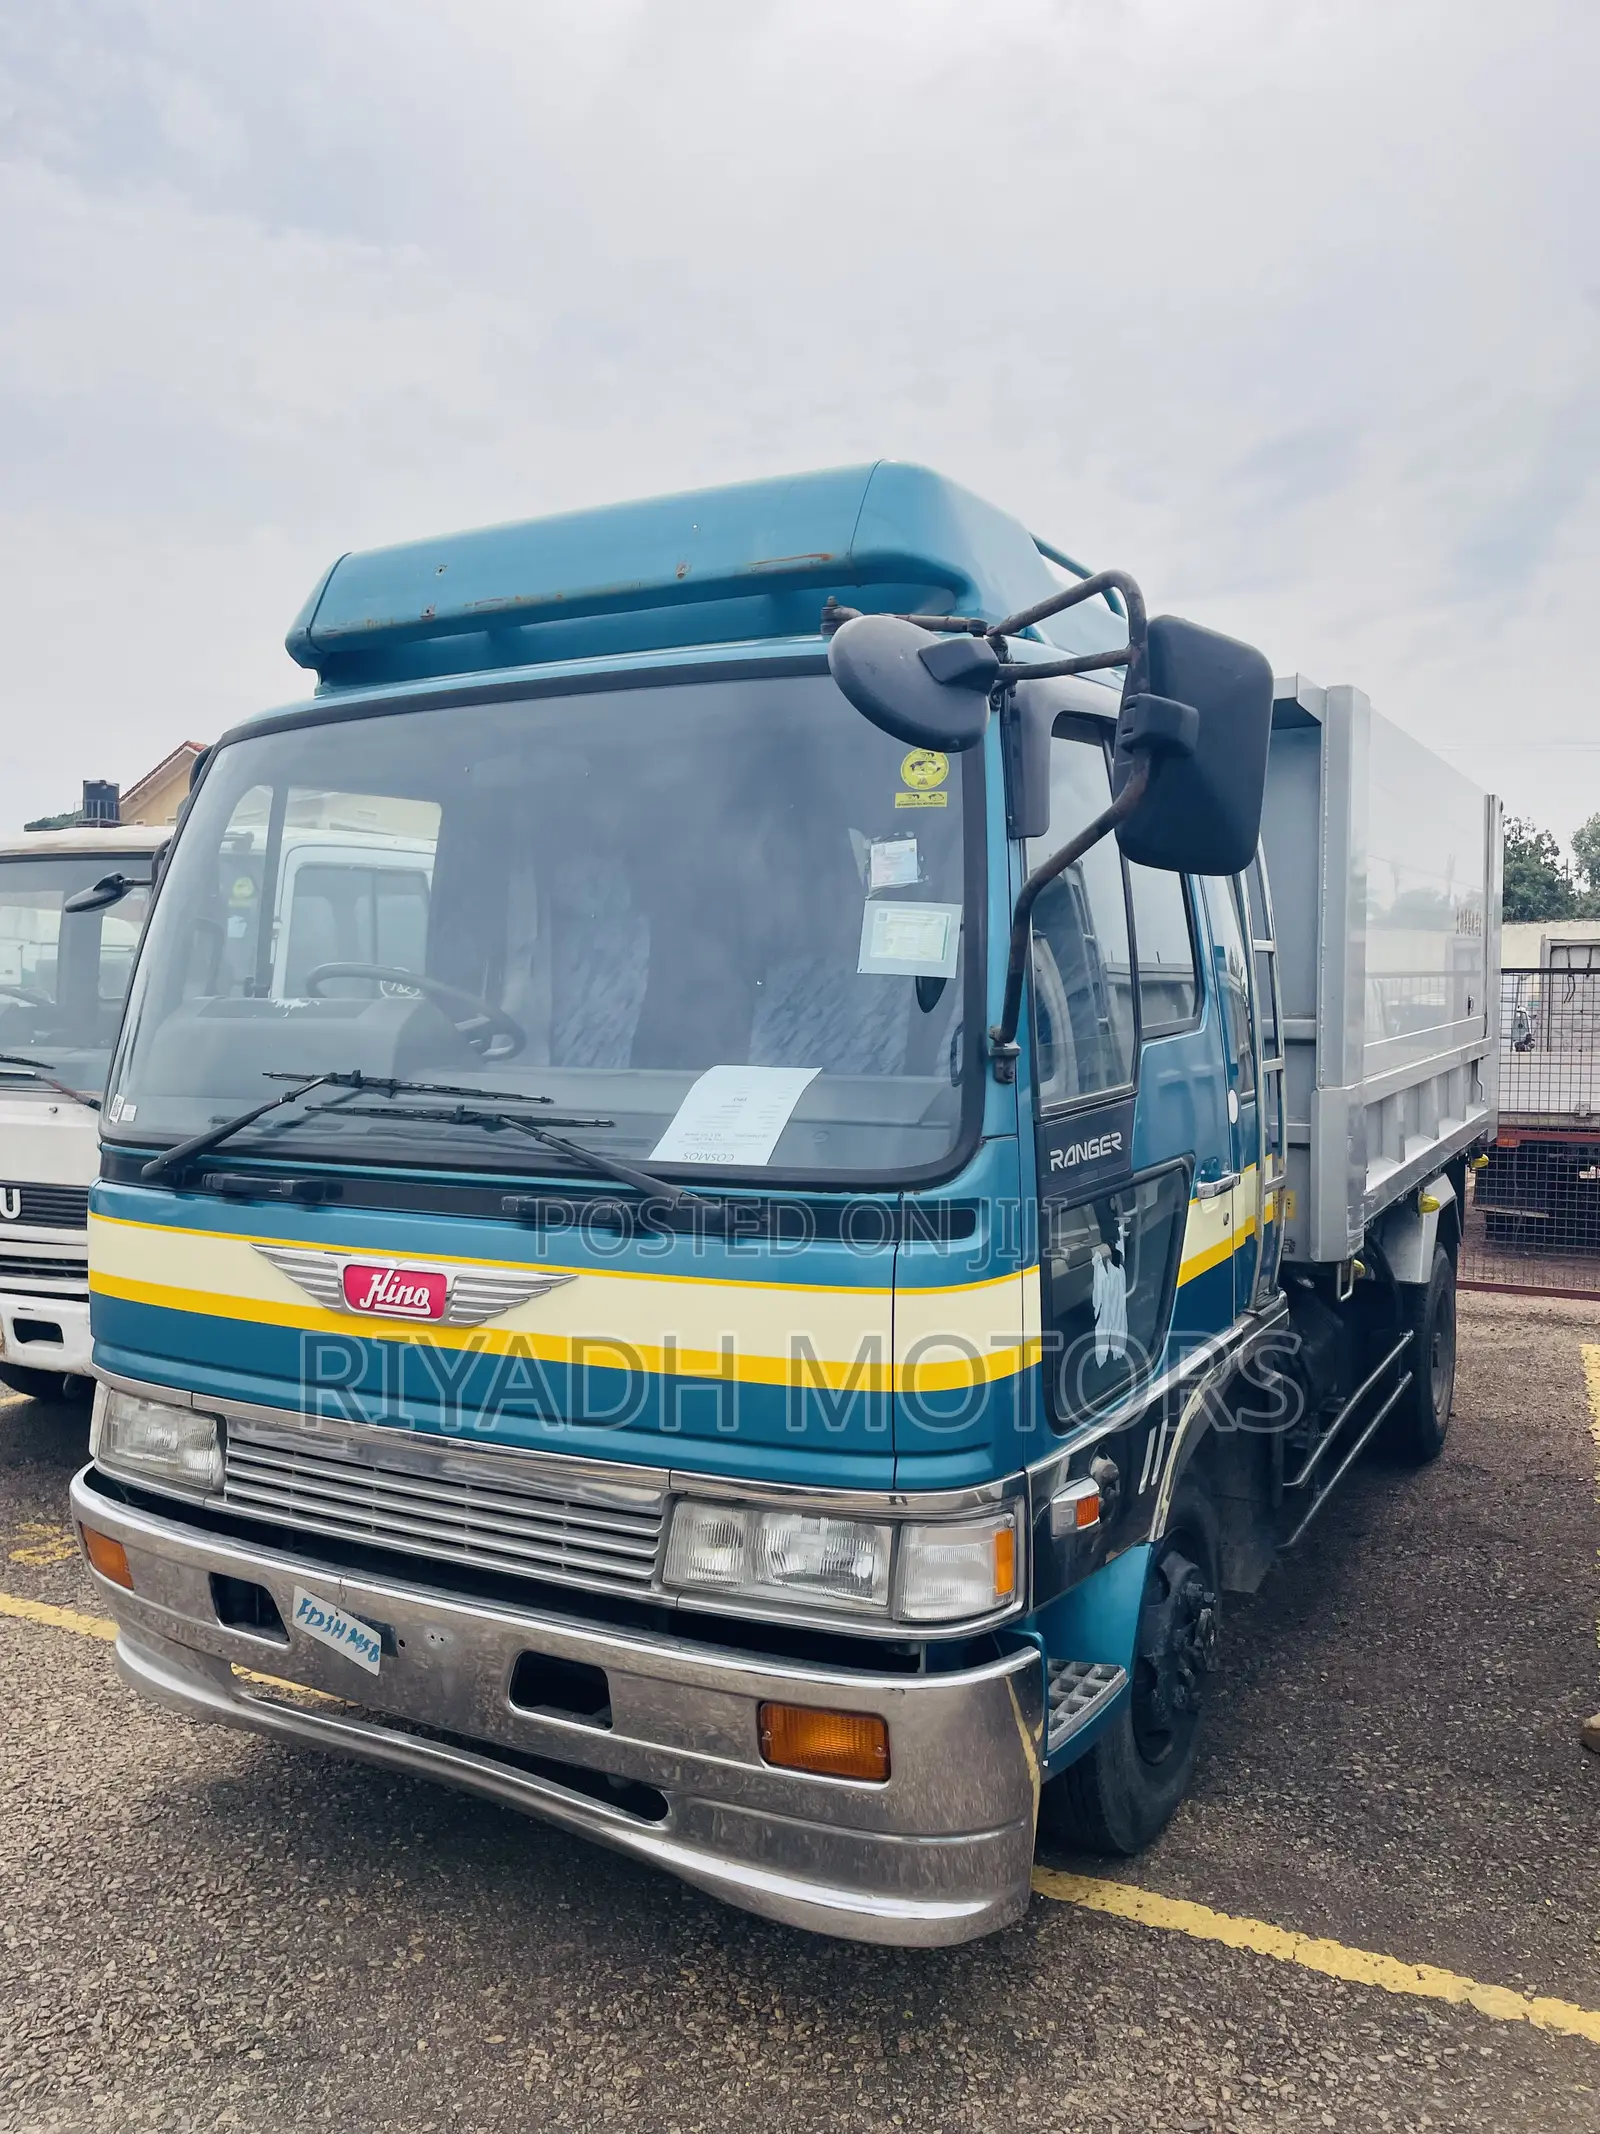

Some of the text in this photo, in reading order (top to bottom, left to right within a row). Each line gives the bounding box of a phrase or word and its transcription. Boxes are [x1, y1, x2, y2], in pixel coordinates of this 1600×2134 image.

[683, 1151, 735, 1163] COSMOS
[1049, 1131, 1123, 1172] RANGER
[359, 1269, 431, 1315] Hino
